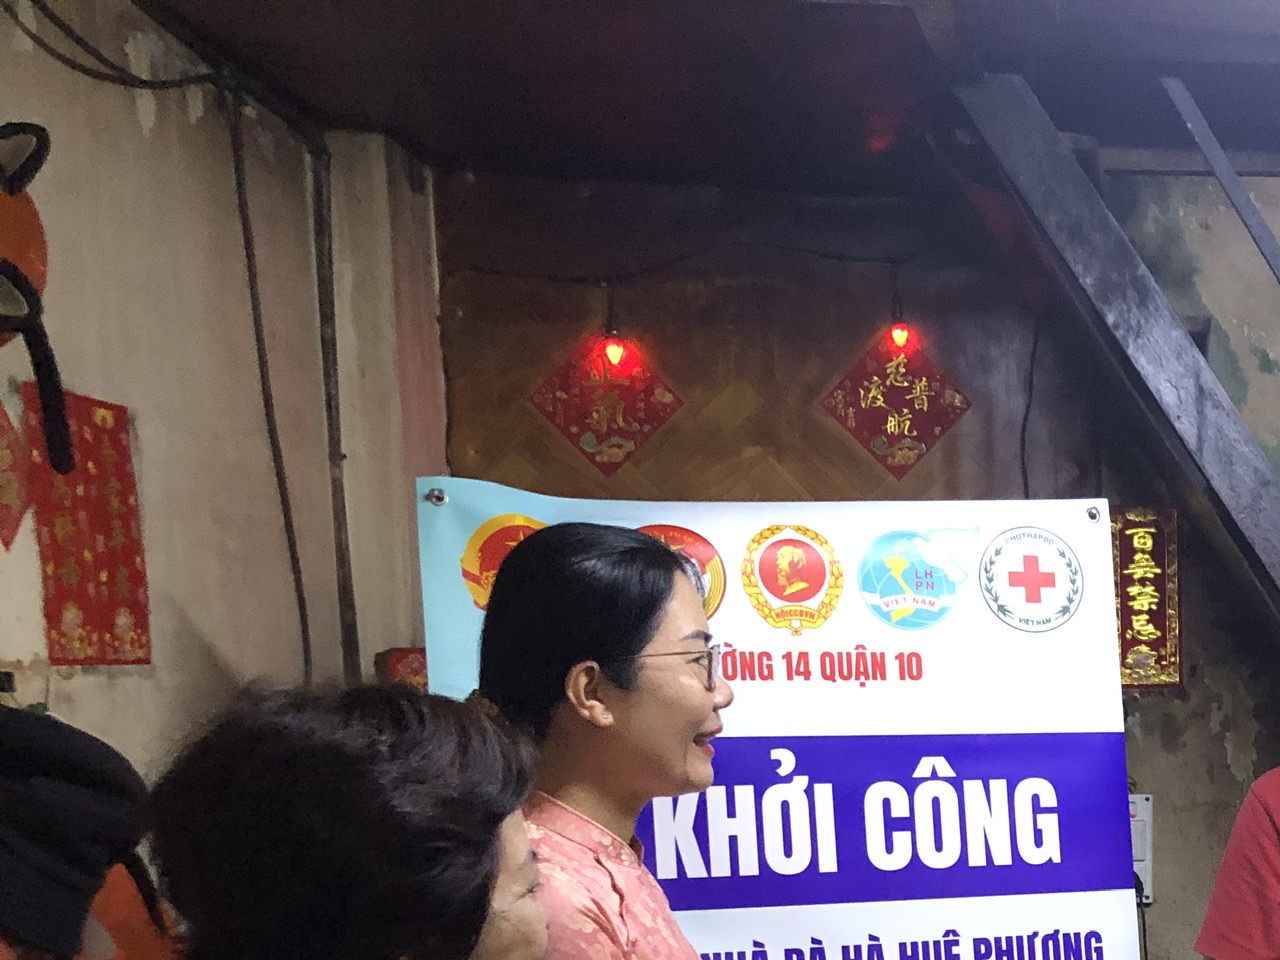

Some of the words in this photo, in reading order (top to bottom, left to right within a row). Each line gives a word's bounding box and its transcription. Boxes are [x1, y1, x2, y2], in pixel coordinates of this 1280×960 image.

[912, 597, 936, 608] NAM
[719, 641, 774, 682] ỜNG
[782, 651, 812, 681] 14
[820, 644, 887, 688] QUẬN
[895, 651, 923, 681] 10
[652, 748, 838, 879] KHỞI
[864, 756, 1062, 872] CÔNG
